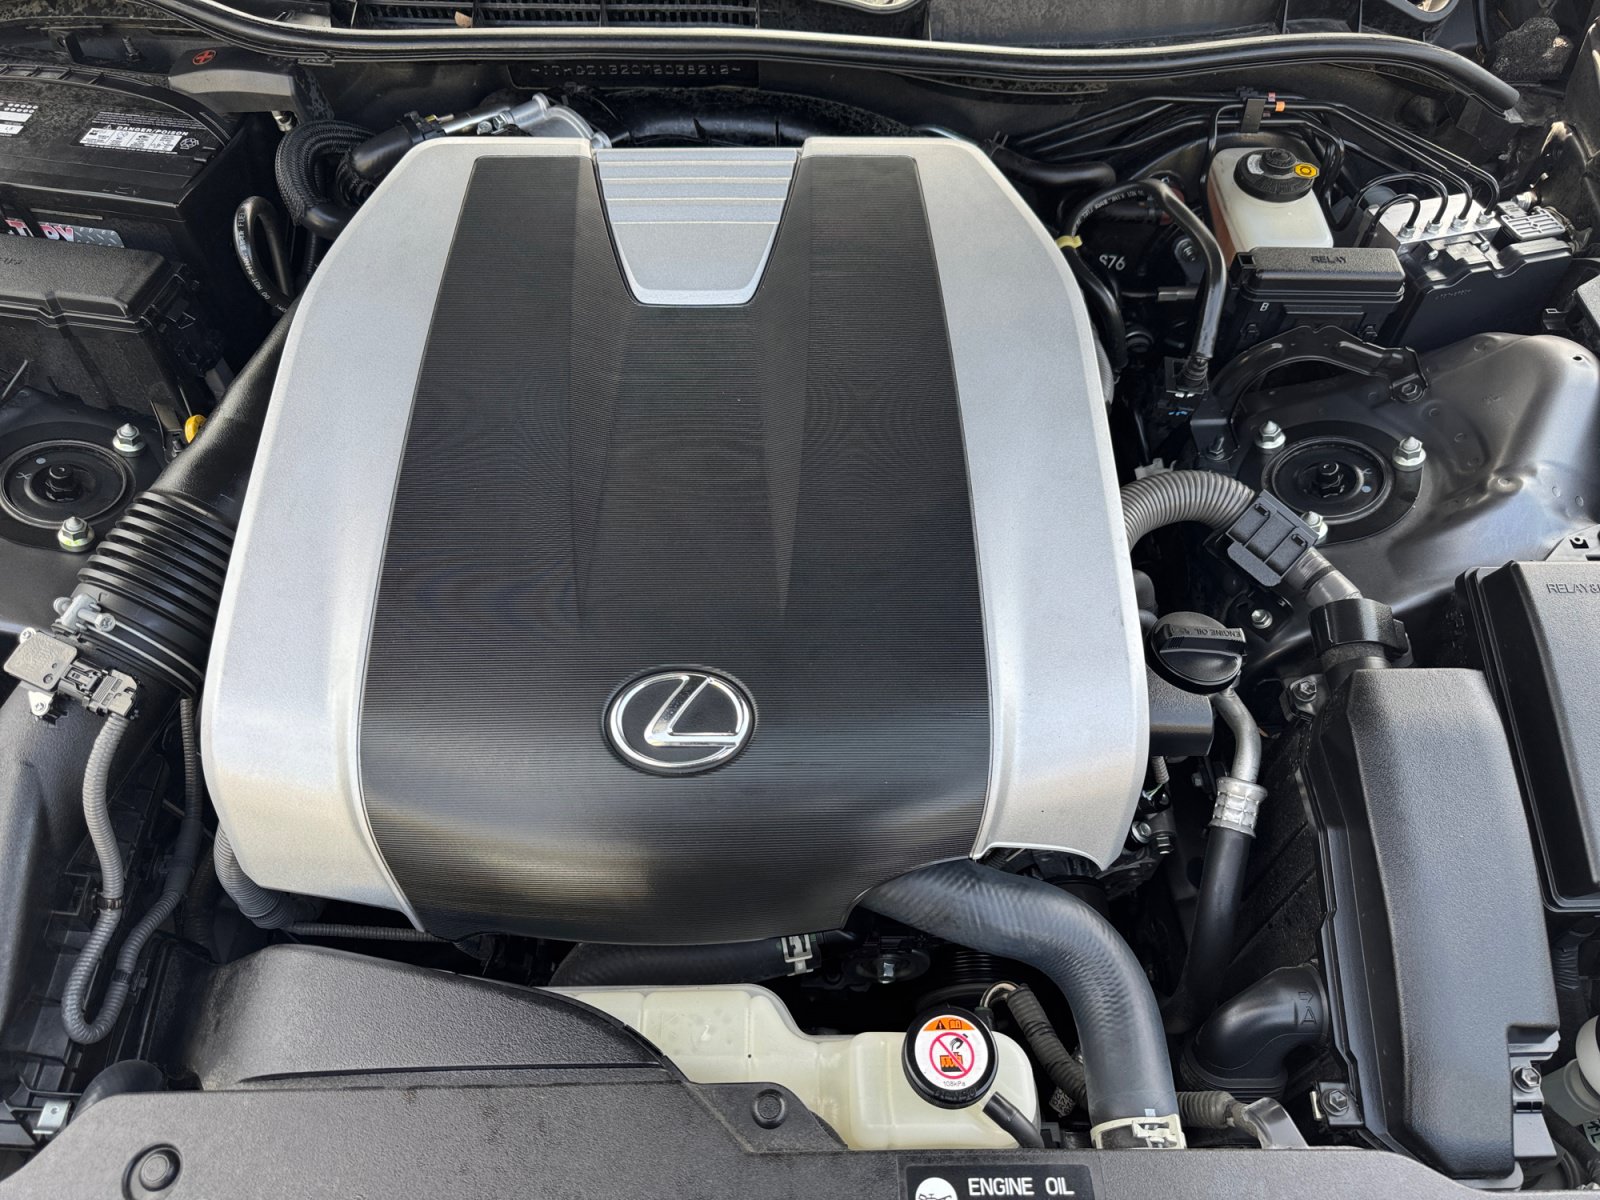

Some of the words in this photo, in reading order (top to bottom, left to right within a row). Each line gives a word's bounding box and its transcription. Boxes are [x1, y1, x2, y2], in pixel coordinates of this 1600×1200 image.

[116, 126, 189, 136] DANGER/POISON
[1311, 255, 1347, 265] RELAY
[967, 1176, 1034, 1196] ENGINE
[1044, 1176, 1075, 1196] OIL
